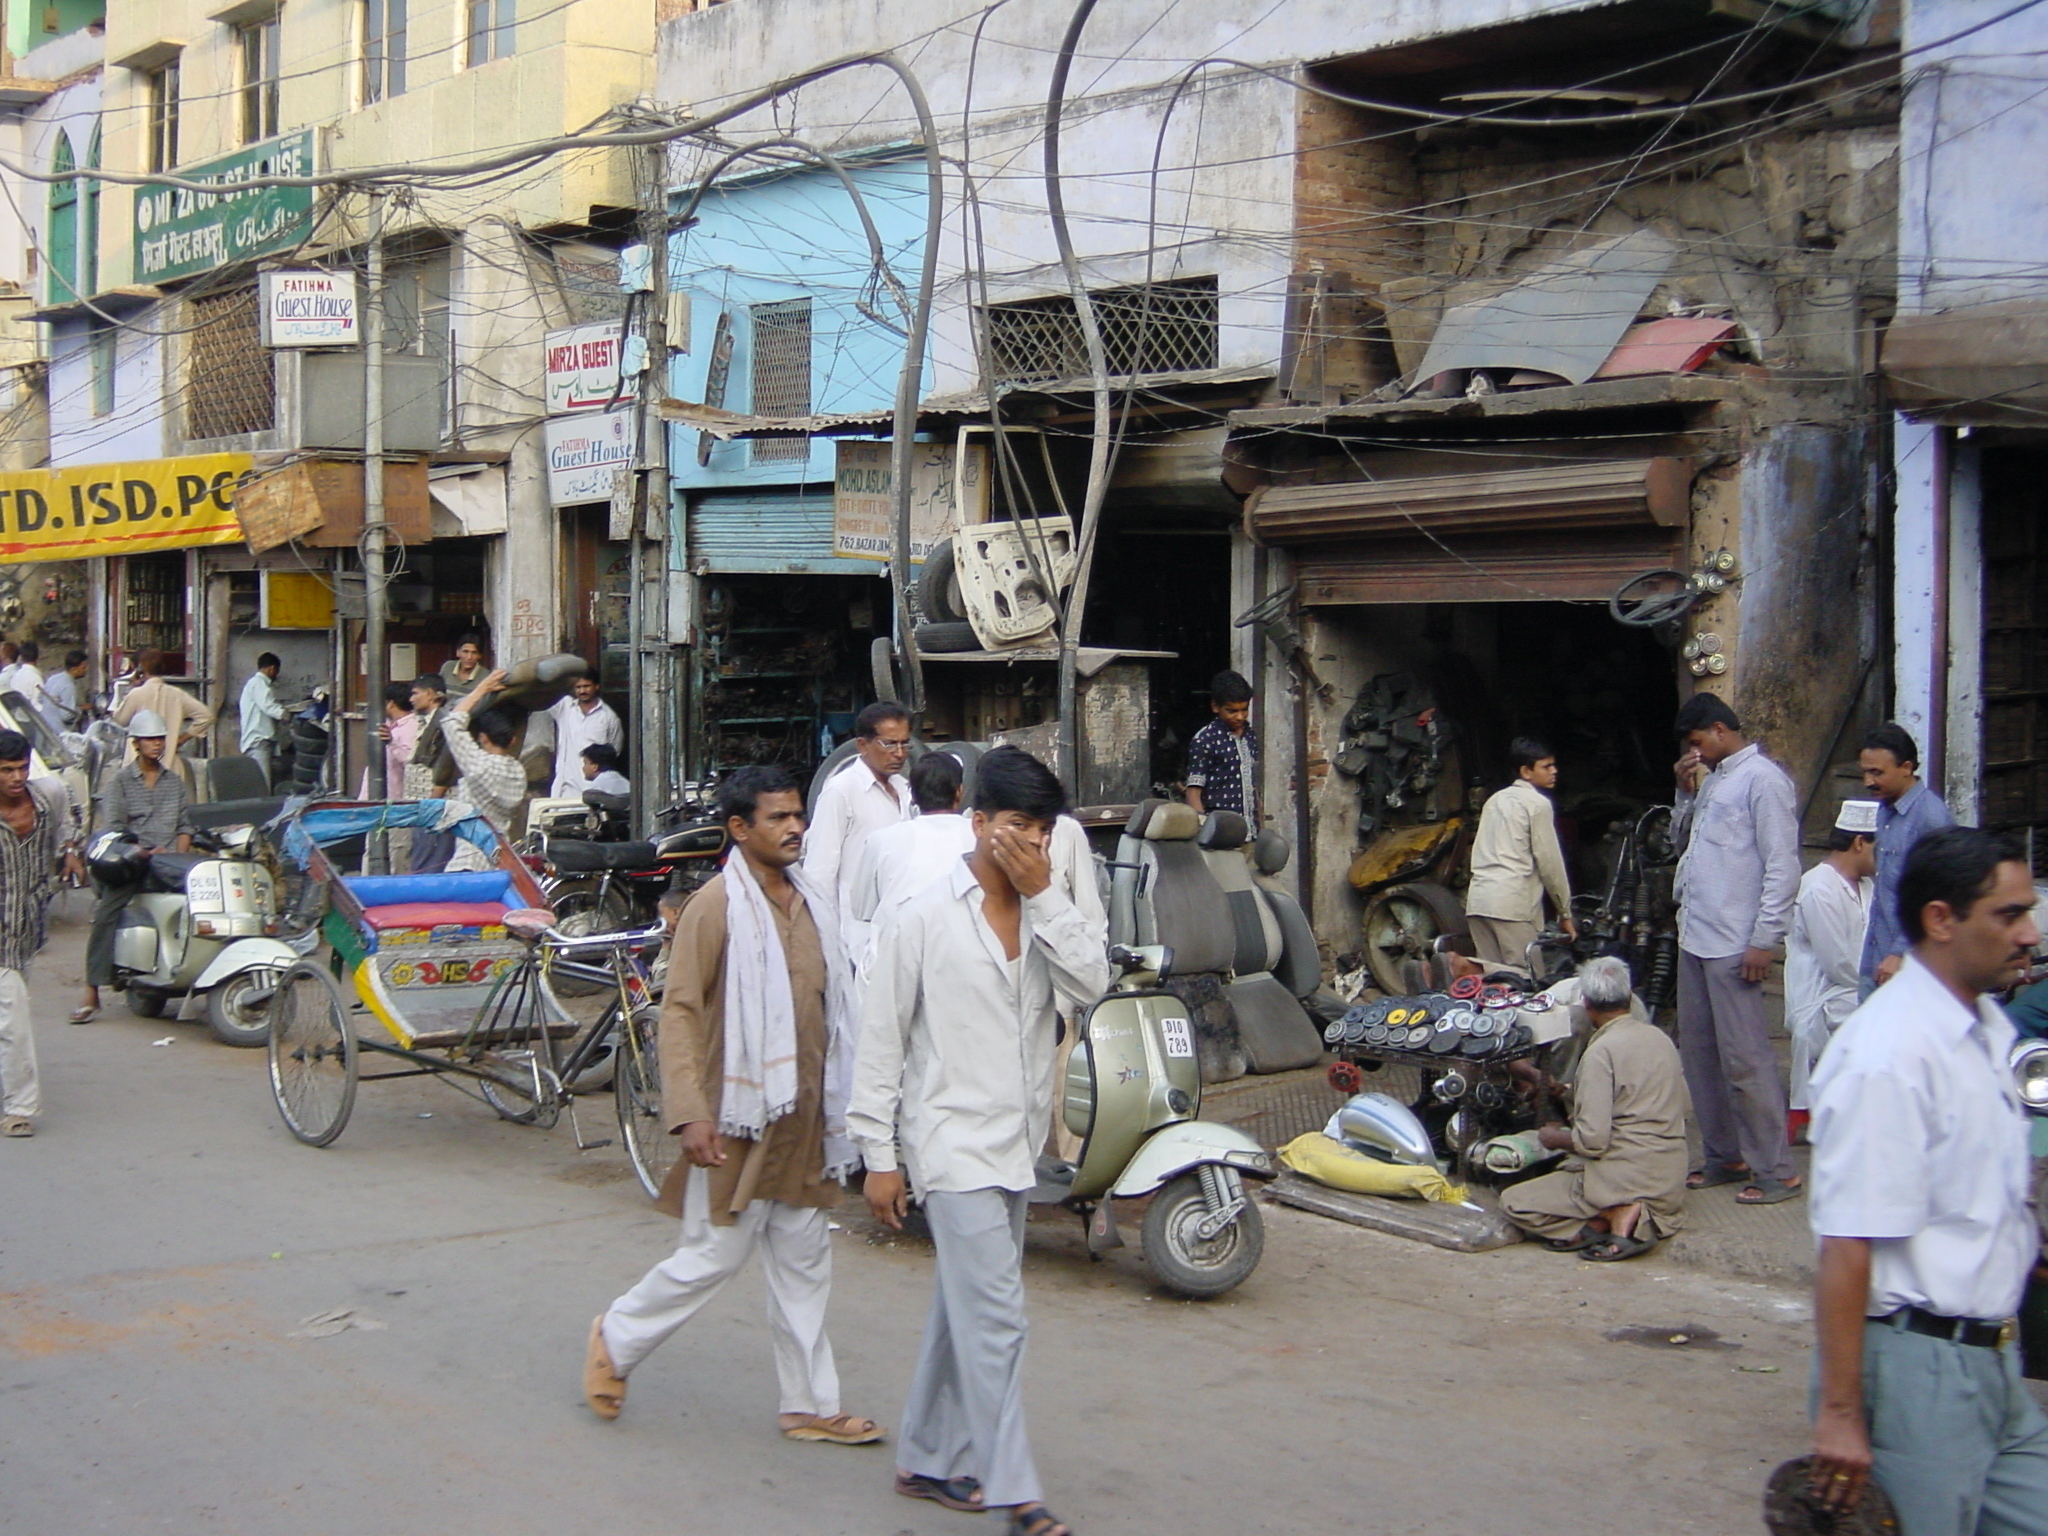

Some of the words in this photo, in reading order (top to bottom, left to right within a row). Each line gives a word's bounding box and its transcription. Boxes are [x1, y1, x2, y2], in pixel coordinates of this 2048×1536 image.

[284, 280, 333, 292] FATIHMA
[276, 292, 312, 317] Guest
[314, 295, 352, 317] House
[548, 345, 580, 373] MIRZA
[582, 340, 614, 369] GUEST
[552, 446, 587, 469] Guest
[590, 440, 632, 463] House
[1168, 1037, 1188, 1054] 789
